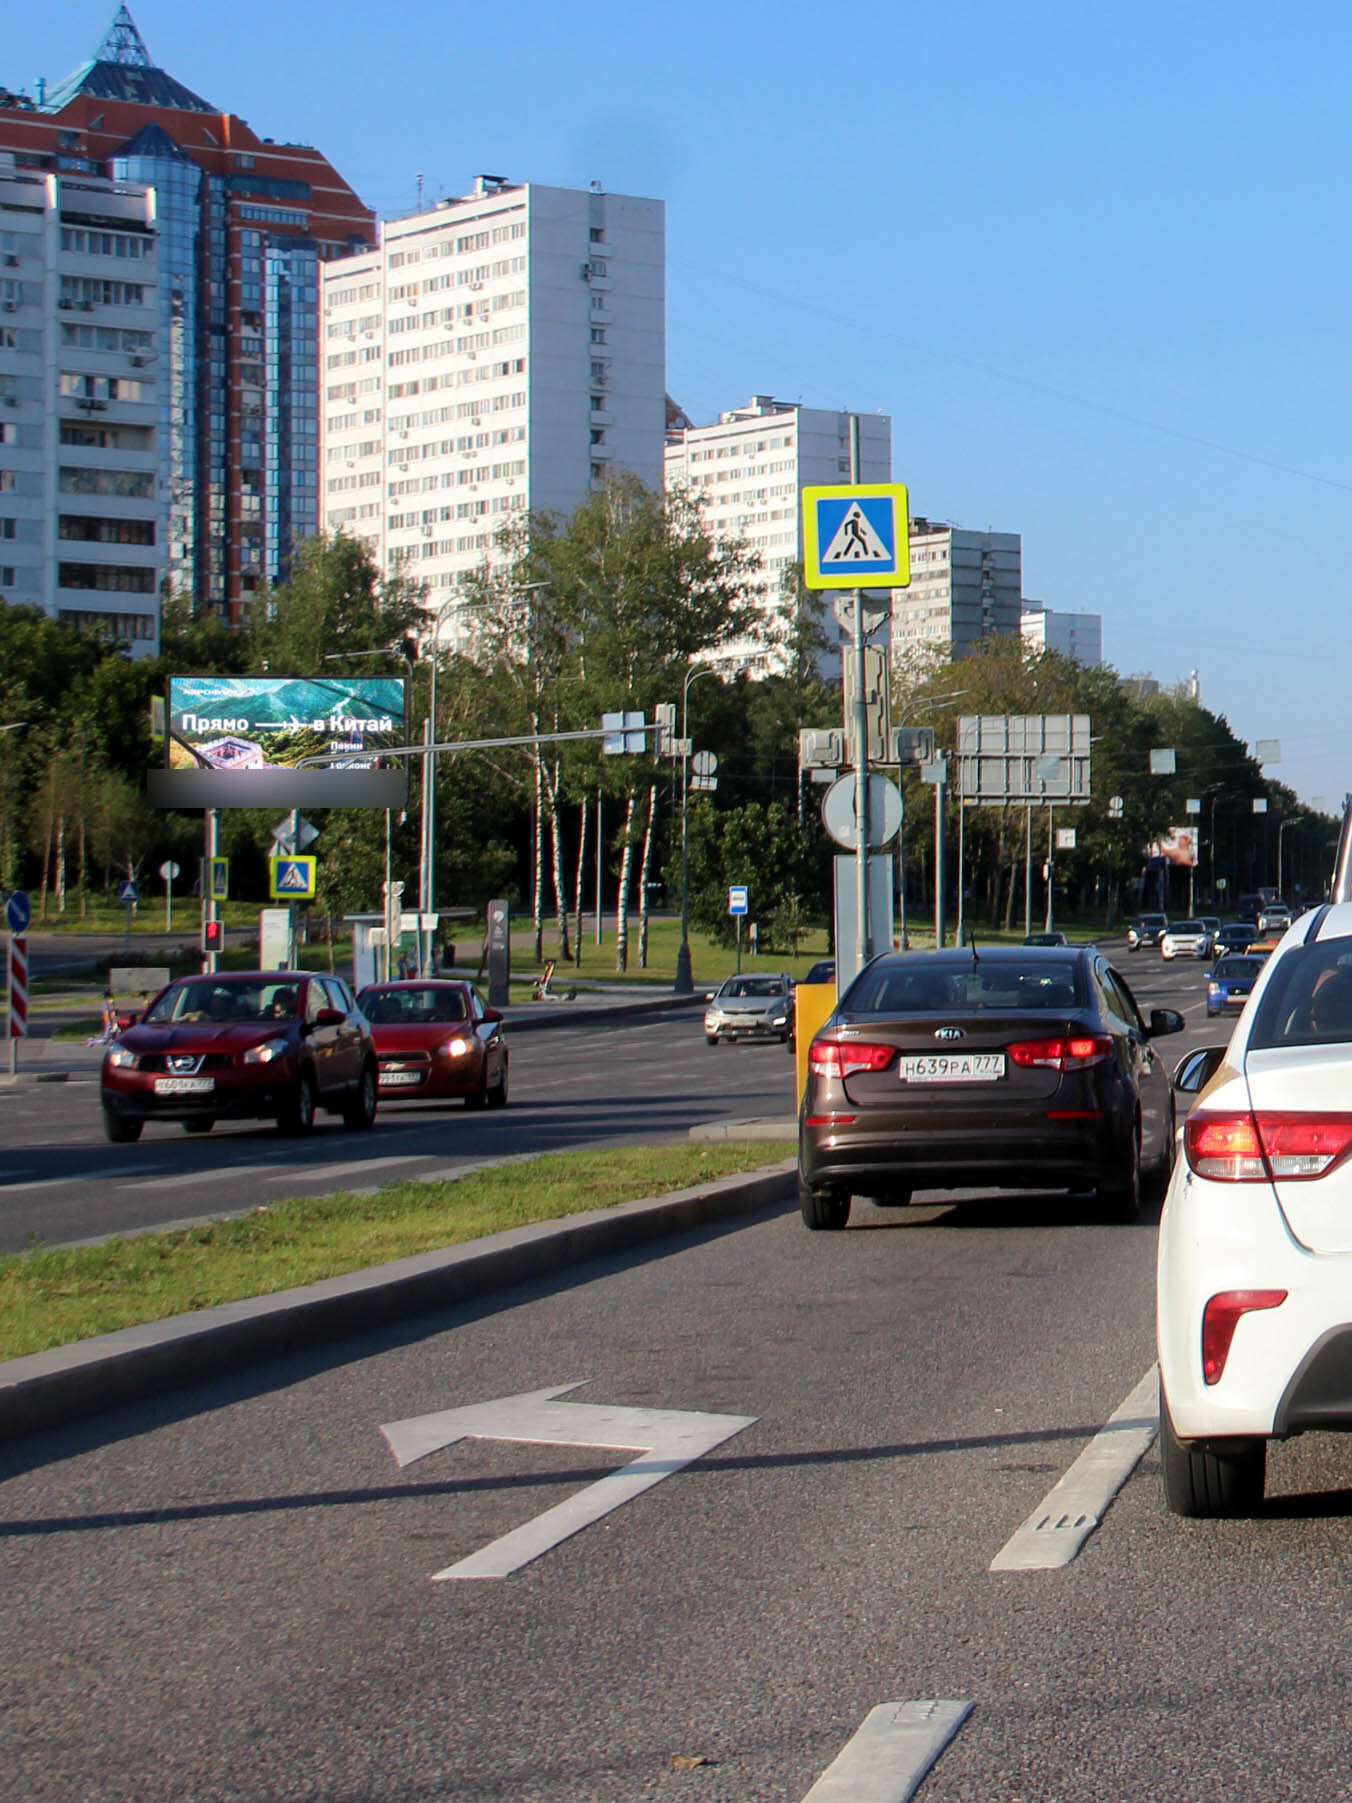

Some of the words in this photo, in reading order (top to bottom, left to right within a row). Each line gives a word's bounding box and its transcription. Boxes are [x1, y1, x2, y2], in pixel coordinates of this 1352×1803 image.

[182, 714, 249, 734] Прямо
[314, 720, 325, 731] в
[331, 715, 393, 732] Китай
[330, 741, 363, 751] Пекин
[330, 761, 373, 769] Гоконг
[940, 1029, 961, 1039] KIA
[905, 1058, 971, 1076] Н639РА
[976, 1056, 1000, 1069] 777
